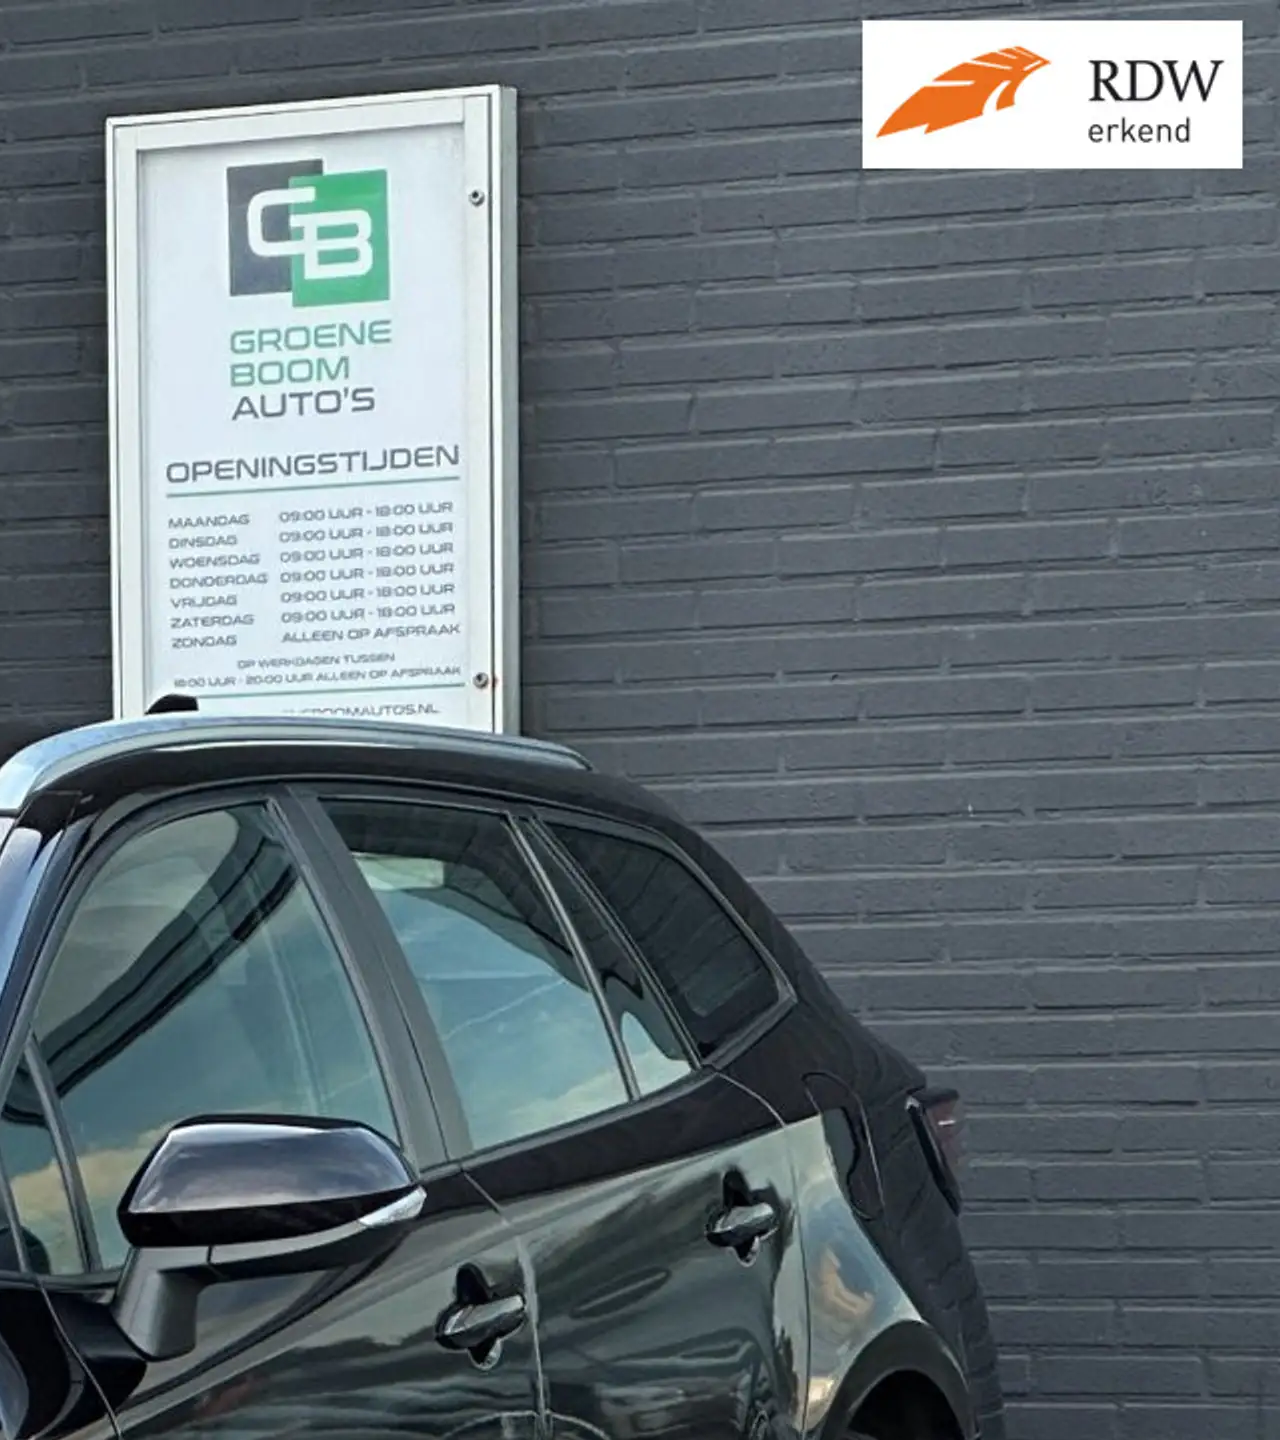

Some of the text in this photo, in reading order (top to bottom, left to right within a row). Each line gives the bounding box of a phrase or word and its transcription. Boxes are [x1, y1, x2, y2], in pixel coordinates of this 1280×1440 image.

[230, 319, 392, 354] GROENE
[230, 356, 350, 387] BOOM
[231, 387, 376, 421] AUTO'S
[166, 444, 460, 484] OPENINGSTIJDEN
[168, 513, 251, 529] MAANDAG
[279, 510, 325, 522] 09:00
[328, 507, 363, 519] UUR
[418, 502, 453, 514] UUR
[168, 534, 238, 550] DINSDAG
[279, 530, 325, 542] 09:00
[329, 528, 363, 540] UUR
[418, 522, 453, 534] UUR
[169, 553, 261, 570] WOENSDAG
[280, 550, 325, 563] 09:00
[329, 548, 363, 560] UUR
[419, 542, 453, 554] UUR
[169, 573, 269, 589] DONDERDAG
[280, 570, 326, 583] 09:00
[330, 568, 364, 580] UUR
[420, 563, 454, 575] UUR
[170, 594, 238, 609] VRIJDAG
[280, 590, 326, 603] 09:00
[330, 588, 365, 600] UUR
[420, 583, 455, 595] UUR
[170, 614, 255, 629] ZATERDAG
[281, 610, 327, 623] 09:00
[331, 608, 365, 620] UUR
[421, 604, 455, 616] UUR
[171, 624, 461, 649] ZONDAG ALLEEN OP AFSPRAAK
